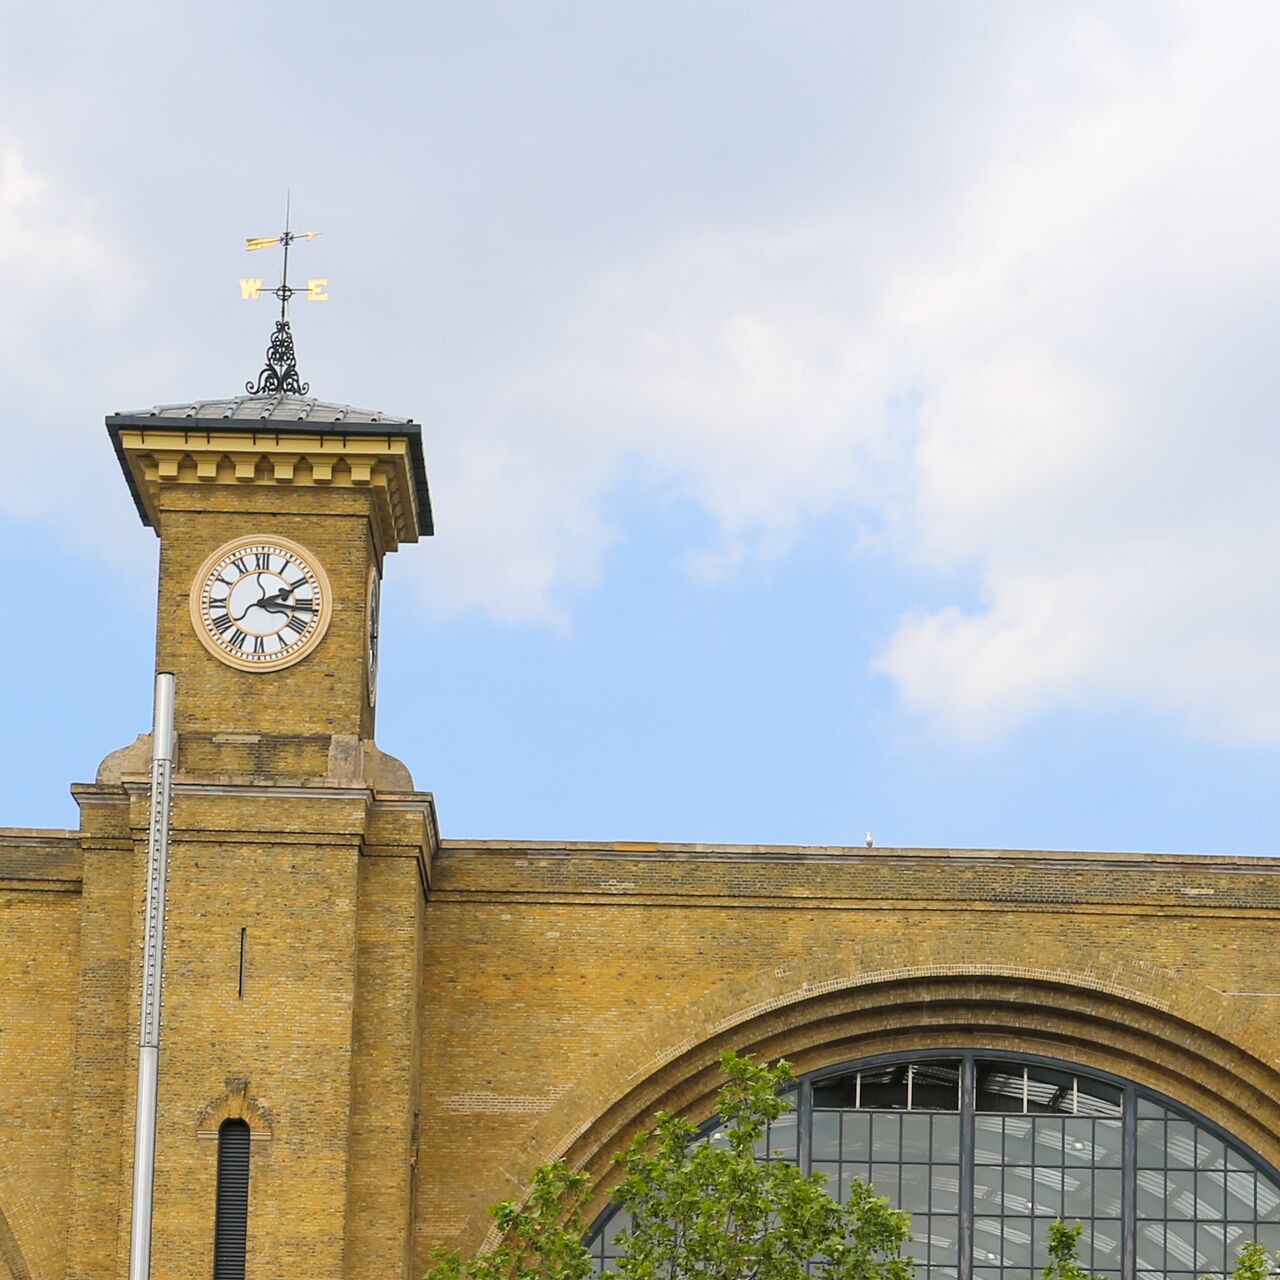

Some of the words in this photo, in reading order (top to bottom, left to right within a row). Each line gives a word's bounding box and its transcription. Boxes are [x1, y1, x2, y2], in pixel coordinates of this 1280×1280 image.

[233, 558, 248, 575] XI
[255, 554, 270, 570] XII
[280, 560, 289, 575] I
[216, 574, 232, 587] X
[290, 577, 308, 590] II
[210, 598, 226, 608] IX
[213, 614, 234, 634] VIII
[287, 615, 309, 636] IIII
[229, 629, 248, 650] VII
[254, 636, 265, 654] VI
[277, 632, 288, 648] V
